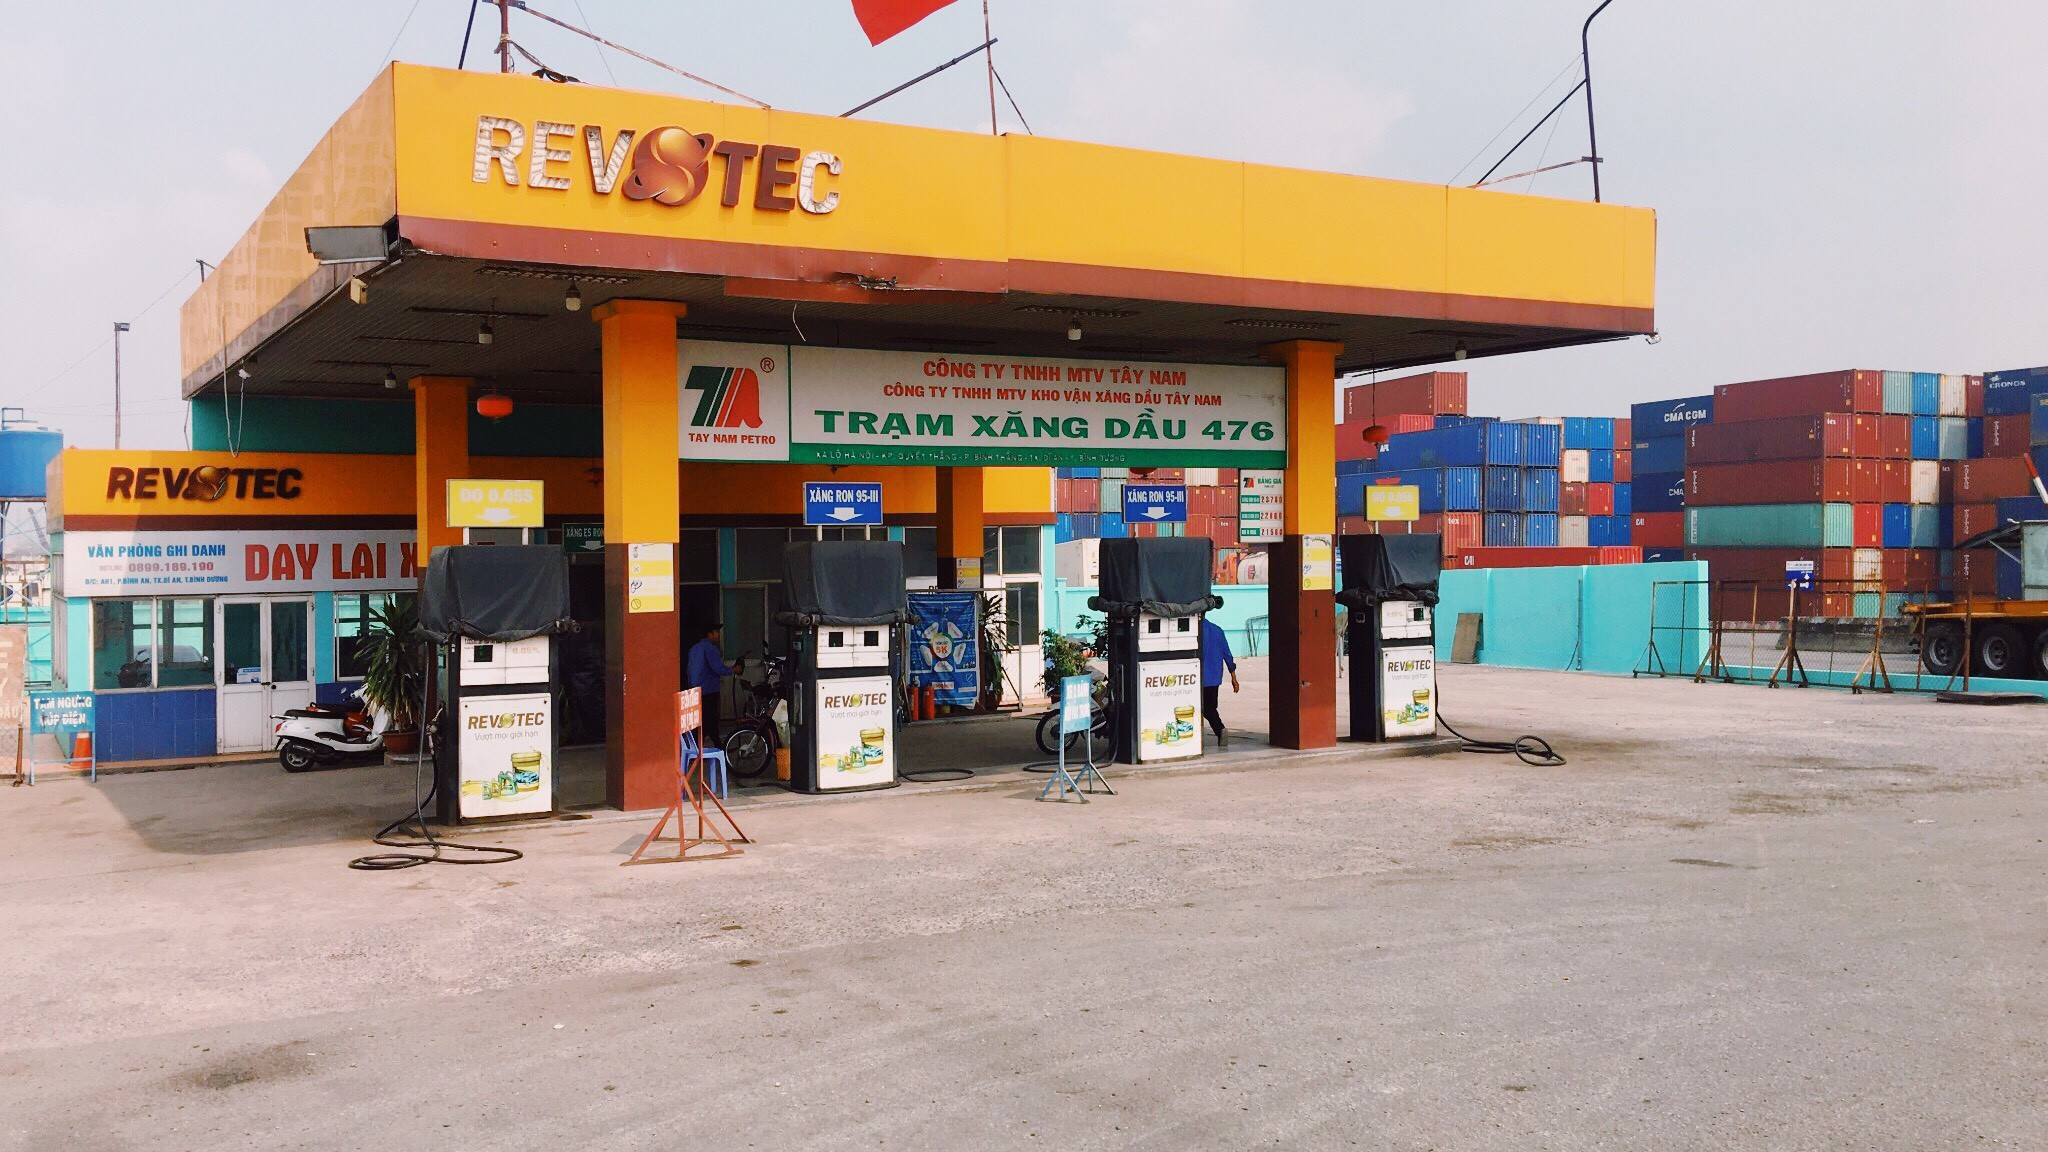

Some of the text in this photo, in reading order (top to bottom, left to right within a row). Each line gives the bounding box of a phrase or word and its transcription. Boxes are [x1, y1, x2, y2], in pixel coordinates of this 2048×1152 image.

[924, 358, 1187, 386] CÔNG TY TNHH MTV TÂY NAM
[1989, 380, 2026, 389] CRONOS
[883, 382, 1222, 406] CÔNG TY TNHH MTV KHO VẬN XĂNG DẦU TÂY NAM
[1664, 409, 1707, 423] CMA CGM
[815, 408, 1275, 442] TRẠM XĂNG DẦU 476
[688, 433, 776, 444] TAY NAM PETRO
[460, 488, 483, 503] DO
[810, 487, 879, 503] XĂNG RON 95-III
[1128, 489, 1184, 503] XĂNG RON 95-III
[1668, 488, 1684, 497] CMA
[1448, 516, 1460, 525] tex
[88, 543, 226, 558] VĂN PHÒNG GHI DANH
[245, 543, 319, 581] DAY
[332, 542, 387, 580] LAI
[936, 645, 949, 654] 5K
